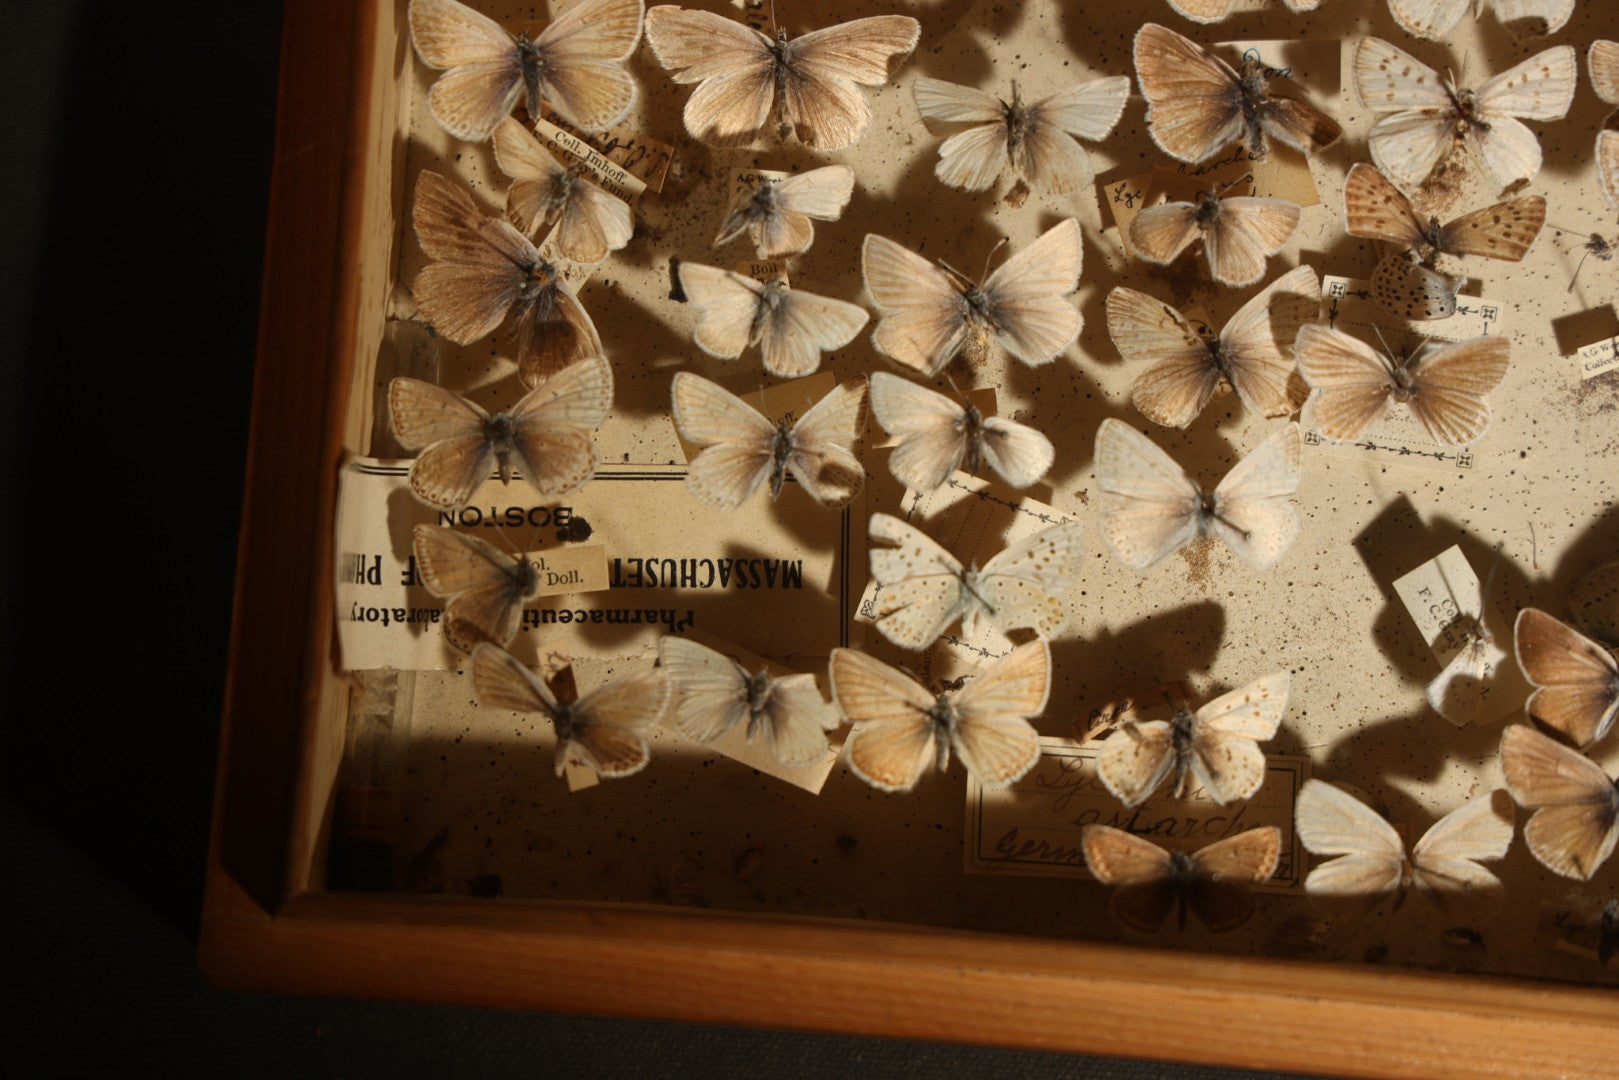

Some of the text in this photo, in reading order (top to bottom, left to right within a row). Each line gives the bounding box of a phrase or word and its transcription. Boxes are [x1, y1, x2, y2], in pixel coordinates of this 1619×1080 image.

[555, 131, 581, 154] Coll.
[584, 150, 628, 185] Imhoff.
[437, 506, 574, 528] BOSTON
[400, 555, 425, 586] F
[532, 557, 550, 570] ol.
[547, 570, 584, 586] Doll.
[609, 557, 803, 589] MASSACHUSET
[350, 601, 695, 632] Pharmaceuti aboratory
